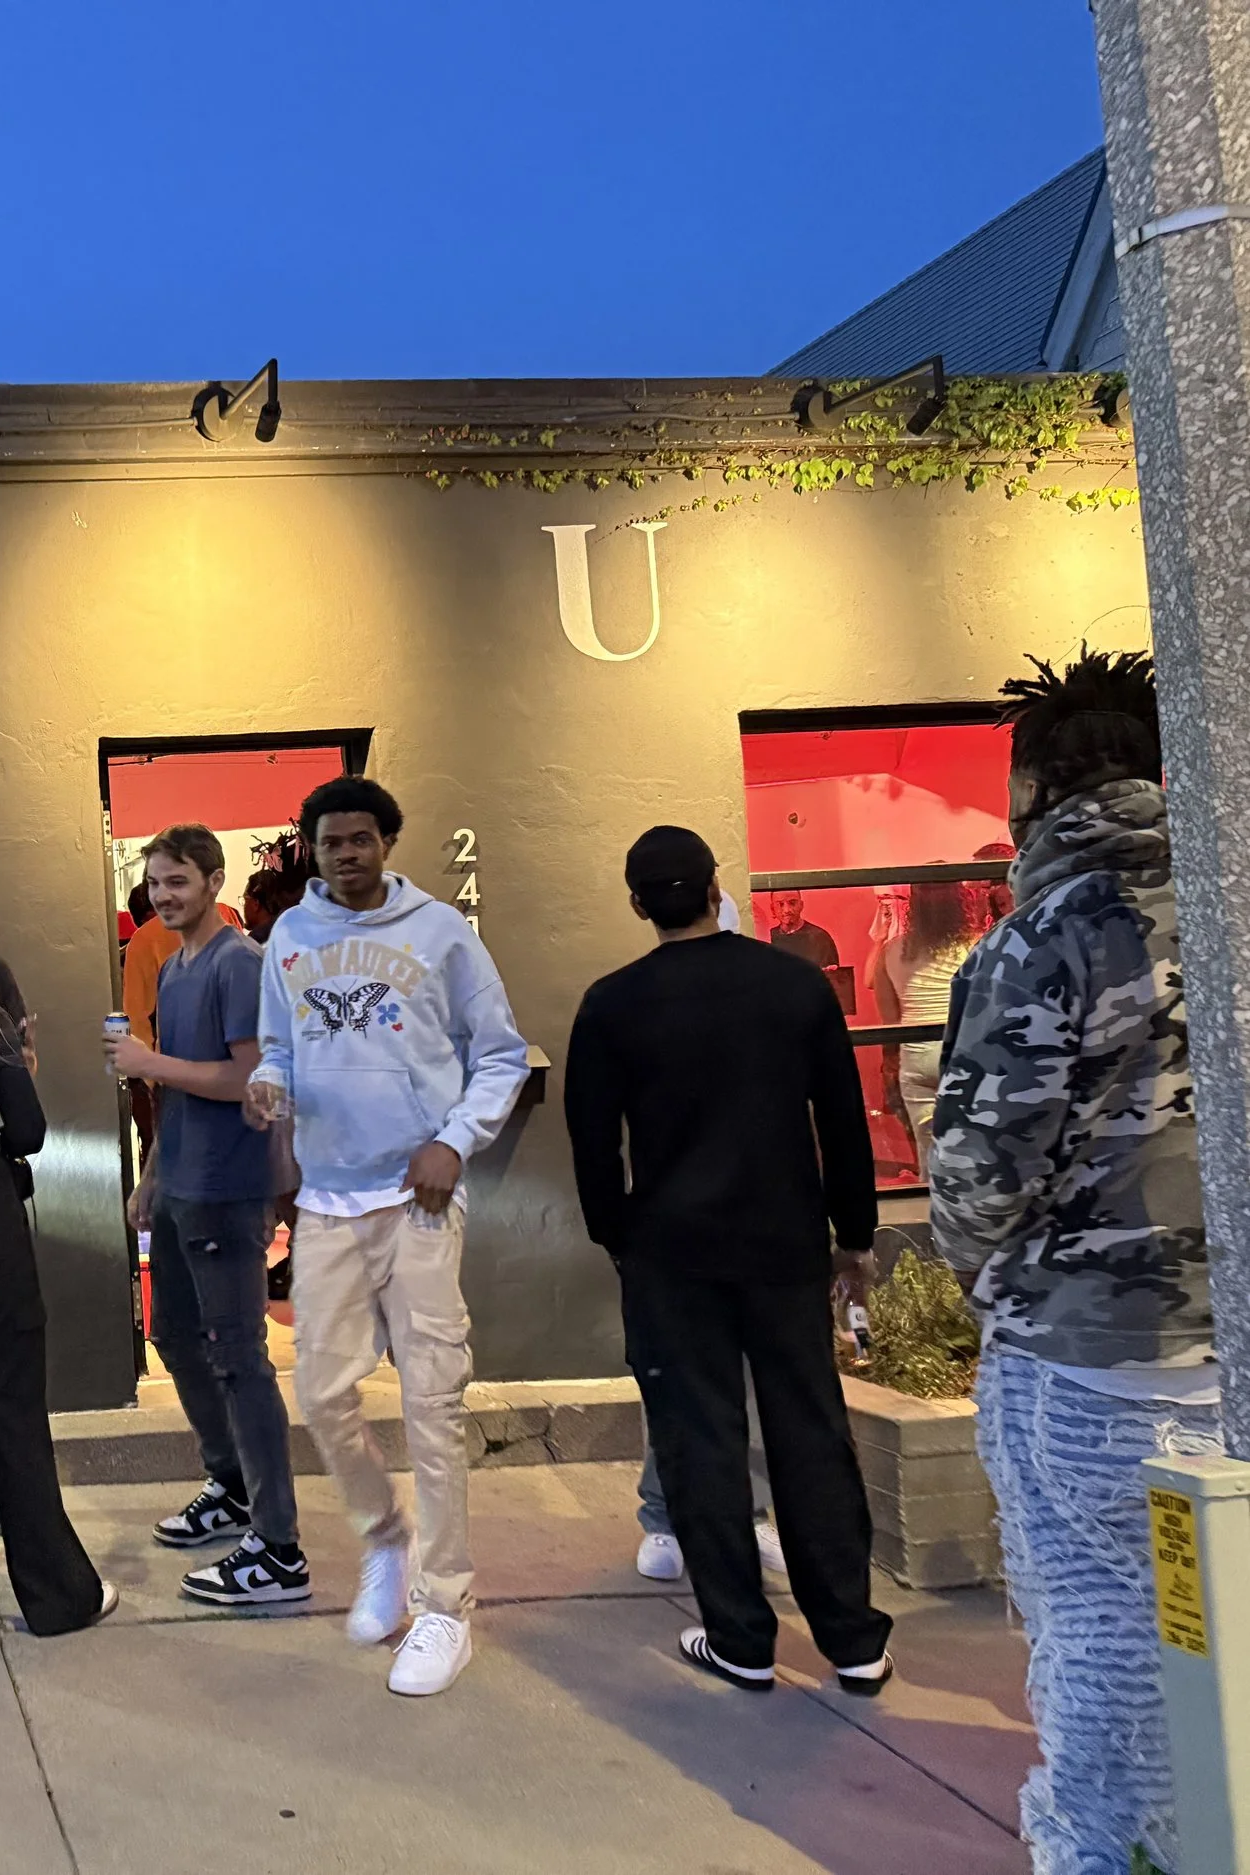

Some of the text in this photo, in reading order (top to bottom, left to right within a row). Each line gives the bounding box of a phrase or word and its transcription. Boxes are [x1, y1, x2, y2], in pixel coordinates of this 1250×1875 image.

[540, 520, 669, 662] U
[282, 939, 431, 1002] MILWAUKEE
[1149, 1489, 1192, 1516] CAUTION
[1157, 1547, 1179, 1565] KEEP
